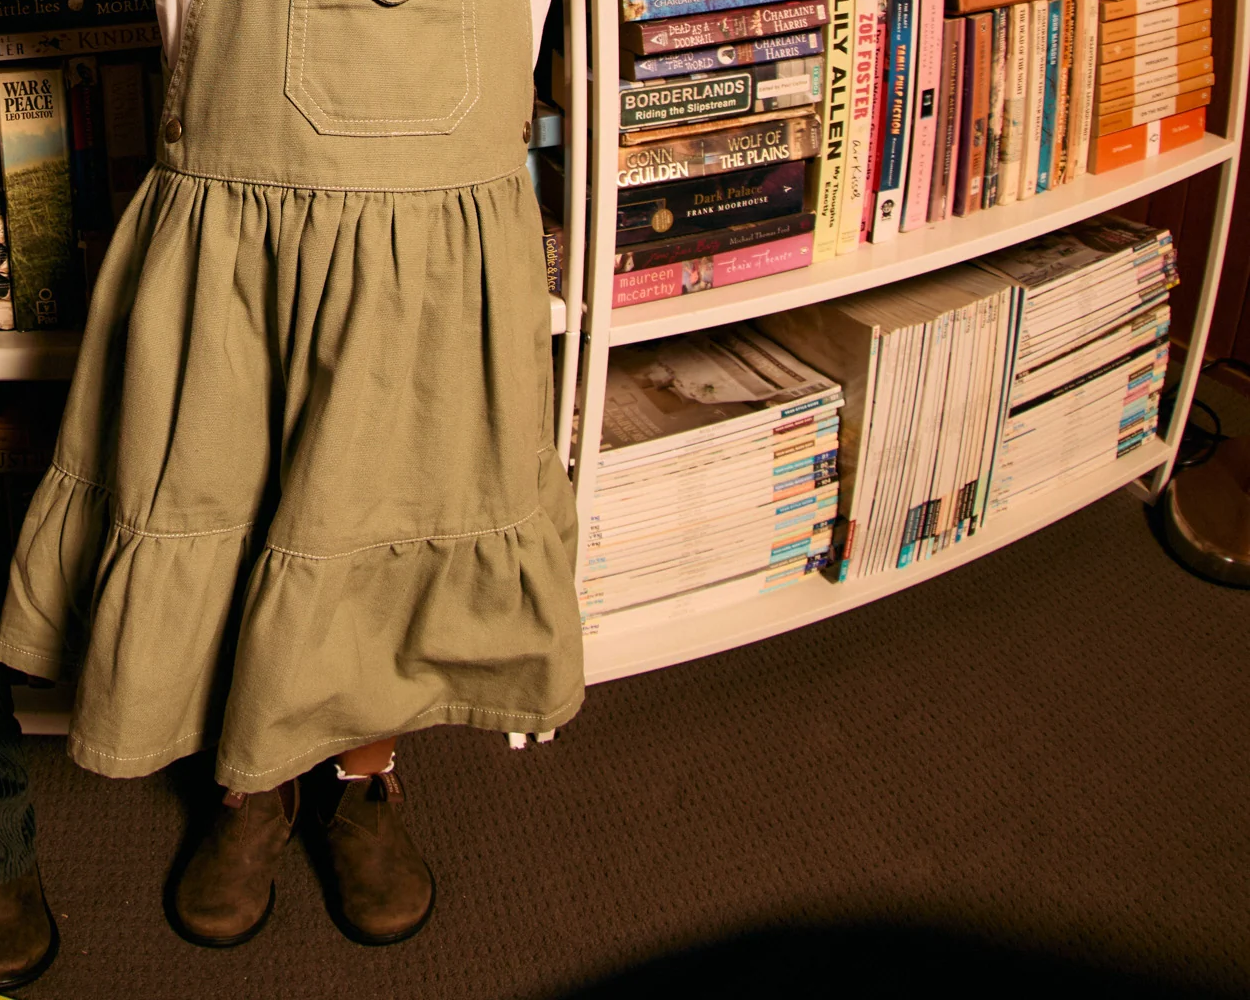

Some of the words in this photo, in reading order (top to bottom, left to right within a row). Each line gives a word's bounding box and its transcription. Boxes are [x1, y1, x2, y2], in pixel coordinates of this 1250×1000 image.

[762, 5, 816, 22] CHARLAINE
[774, 19, 809, 31] HARRIS
[754, 34, 808, 50] CHARLAINE
[3, 81, 39, 97] WAR
[625, 80, 745, 109] BORDERLANDS
[854, 54, 872, 120] FOSTER
[4, 96, 54, 113] PEACE
[635, 107, 667, 121] Riding
[669, 104, 685, 116] the
[687, 99, 737, 113] Slipstream
[827, 66, 849, 161] ALLEN
[6, 113, 20, 121] LEO
[21, 111, 54, 120] TOLSTOY
[728, 134, 762, 152] WOLF
[765, 130, 782, 145] OF
[626, 148, 674, 169] CONN
[719, 153, 745, 170] THE
[747, 144, 790, 164] PLAINS
[617, 161, 689, 187] GGULDEN
[694, 189, 724, 205] Dark
[726, 183, 763, 201] Palace
[687, 206, 716, 217] FRANK
[718, 196, 769, 213] MOORHOUSE
[618, 267, 674, 287] maureen
[617, 282, 676, 302] mccarthy
